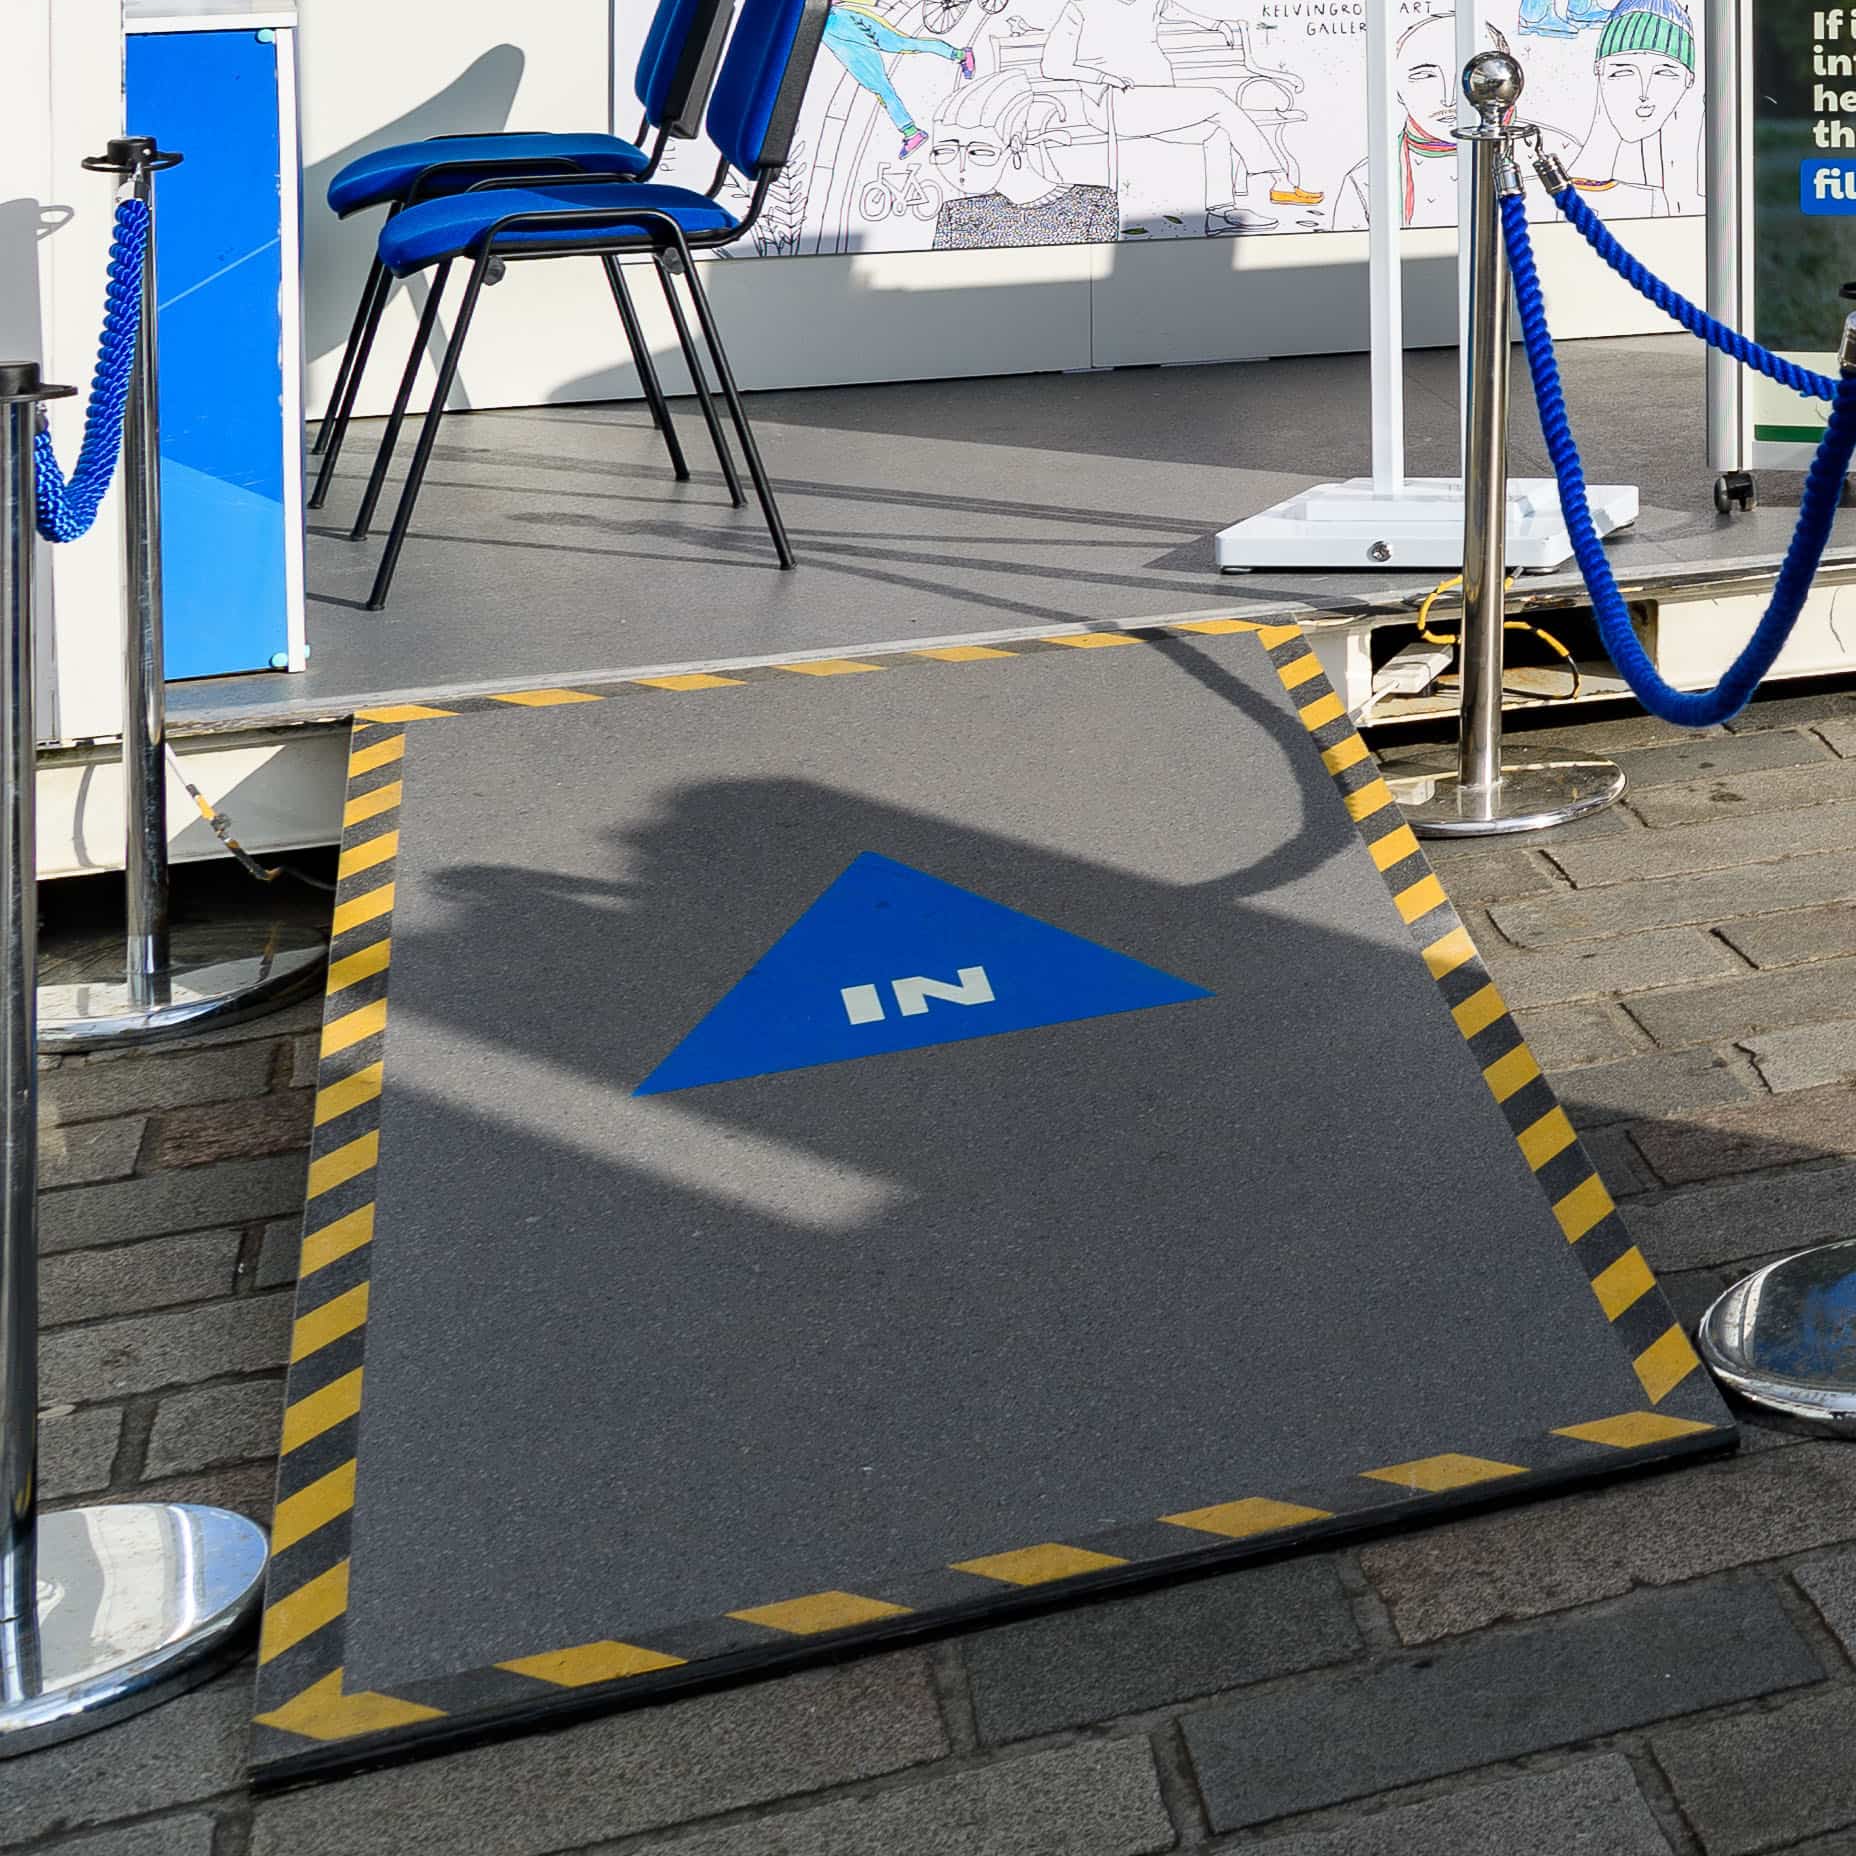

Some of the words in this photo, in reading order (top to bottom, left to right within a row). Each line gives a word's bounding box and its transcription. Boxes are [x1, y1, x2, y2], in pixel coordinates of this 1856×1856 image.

[1400, 1, 1432, 14] ART
[1306, 20, 1367, 36] GALLER
[1813, 9, 1844, 40] If
[841, 966, 995, 1025] IN
